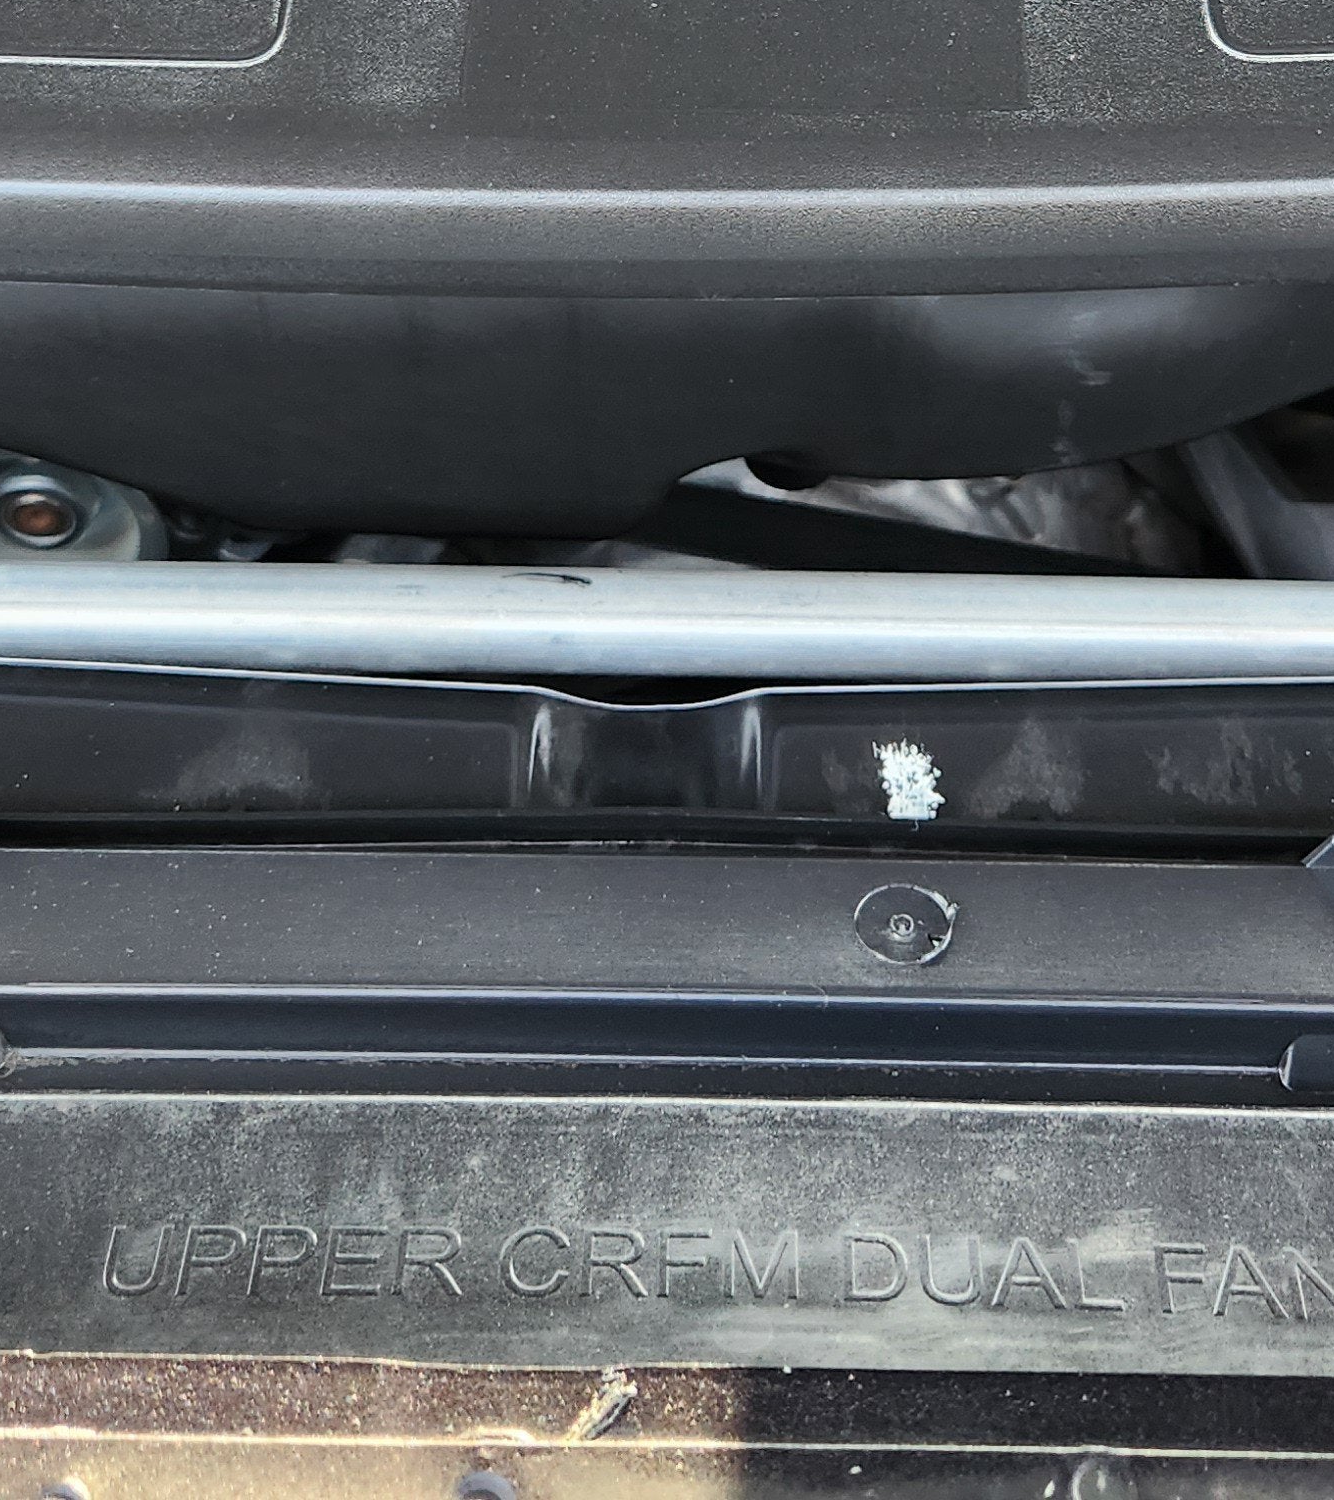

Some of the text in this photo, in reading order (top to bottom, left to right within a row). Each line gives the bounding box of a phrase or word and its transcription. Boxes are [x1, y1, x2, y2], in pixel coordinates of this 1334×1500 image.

[102, 1223, 464, 1297] UPPER
[499, 1224, 800, 1301] CRFM
[844, 1230, 1126, 1312] DUAL
